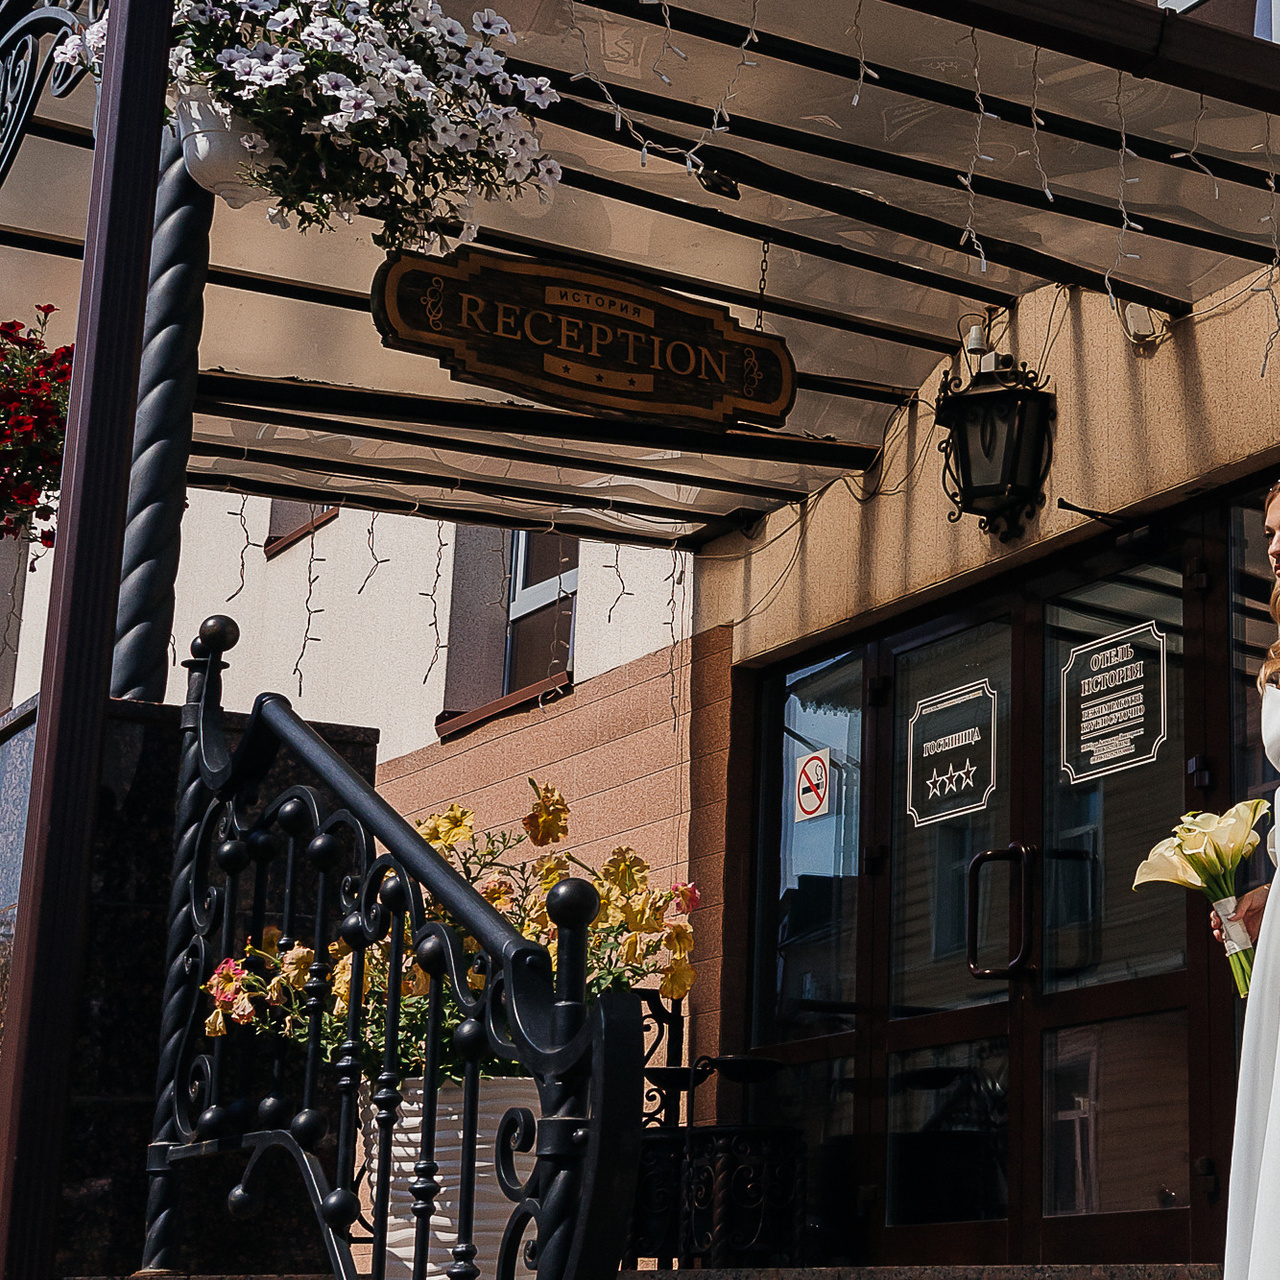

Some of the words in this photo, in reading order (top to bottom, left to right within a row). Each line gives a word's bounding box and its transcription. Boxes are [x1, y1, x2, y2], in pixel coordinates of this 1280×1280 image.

[559, 290, 641, 318] ИСТОРИЯ
[456, 292, 729, 384] RECEPTION
[1090, 643, 1134, 672] ОТЕЛЬ
[1081, 661, 1144, 696] ИСТОРИЯ
[923, 726, 982, 757] ГОСТИНИЦА
